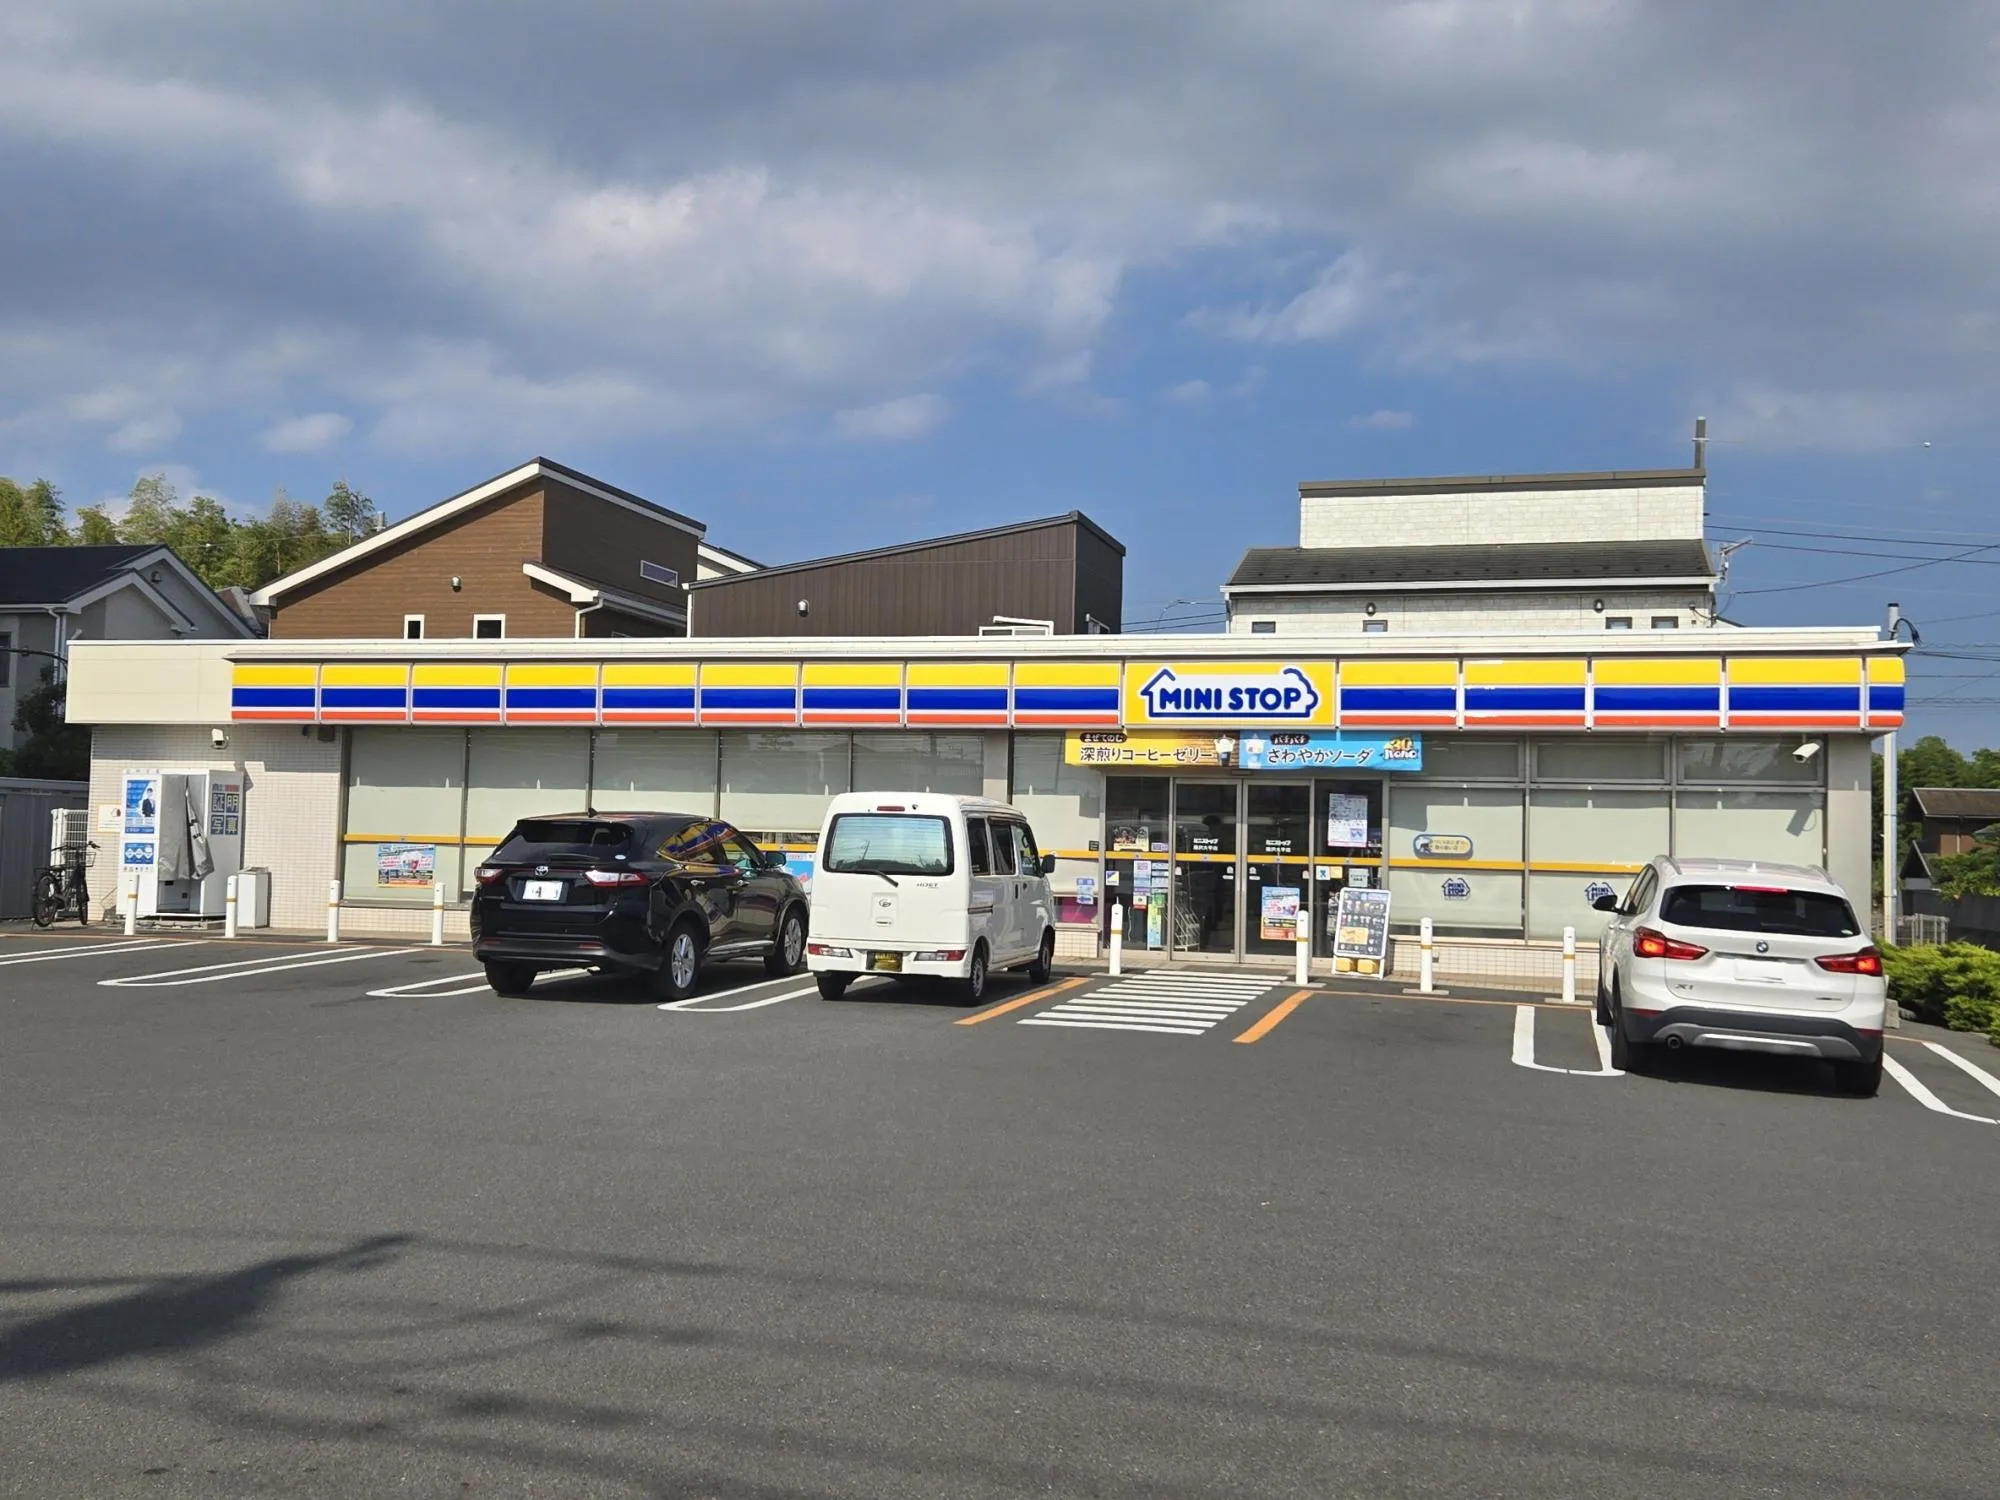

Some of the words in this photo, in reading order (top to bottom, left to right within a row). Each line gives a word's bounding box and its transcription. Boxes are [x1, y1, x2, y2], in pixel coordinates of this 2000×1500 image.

[1159, 687, 1222, 711] MINI
[1228, 687, 1301, 711] STOP
[1084, 734, 1123, 743] まぜてのむ
[1080, 747, 1213, 762] 深煎りコーヒーゼリー
[1267, 748, 1373, 764] さわやかソーダ
[212, 793, 239, 812] 証明
[211, 815, 238, 834] 写真
